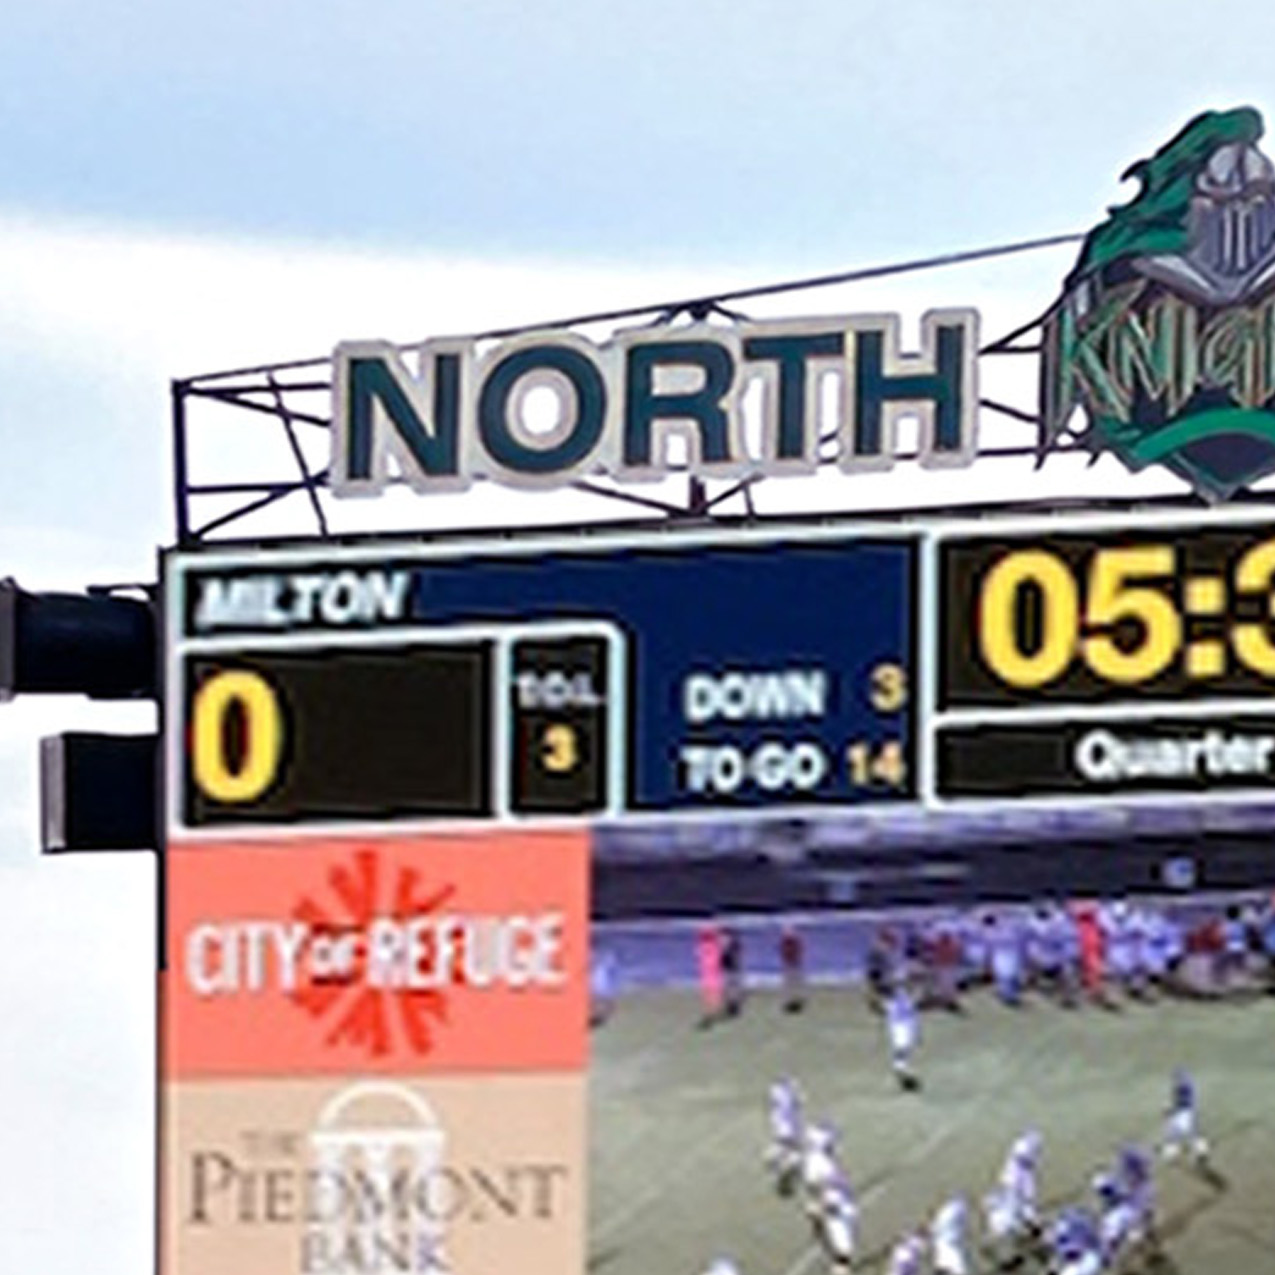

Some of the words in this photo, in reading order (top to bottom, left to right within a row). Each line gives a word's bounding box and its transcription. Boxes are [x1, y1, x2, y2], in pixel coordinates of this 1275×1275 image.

[340, 316, 972, 486] NORTH
[197, 572, 409, 625] MILTON
[683, 671, 828, 721] DOWN
[869, 664, 908, 710] 3
[190, 668, 284, 802] 0
[542, 724, 578, 771] 3
[682, 747, 738, 790] TO
[752, 743, 827, 788] GO
[185, 921, 307, 995] CITY
[301, 1231, 453, 1274] BANK
